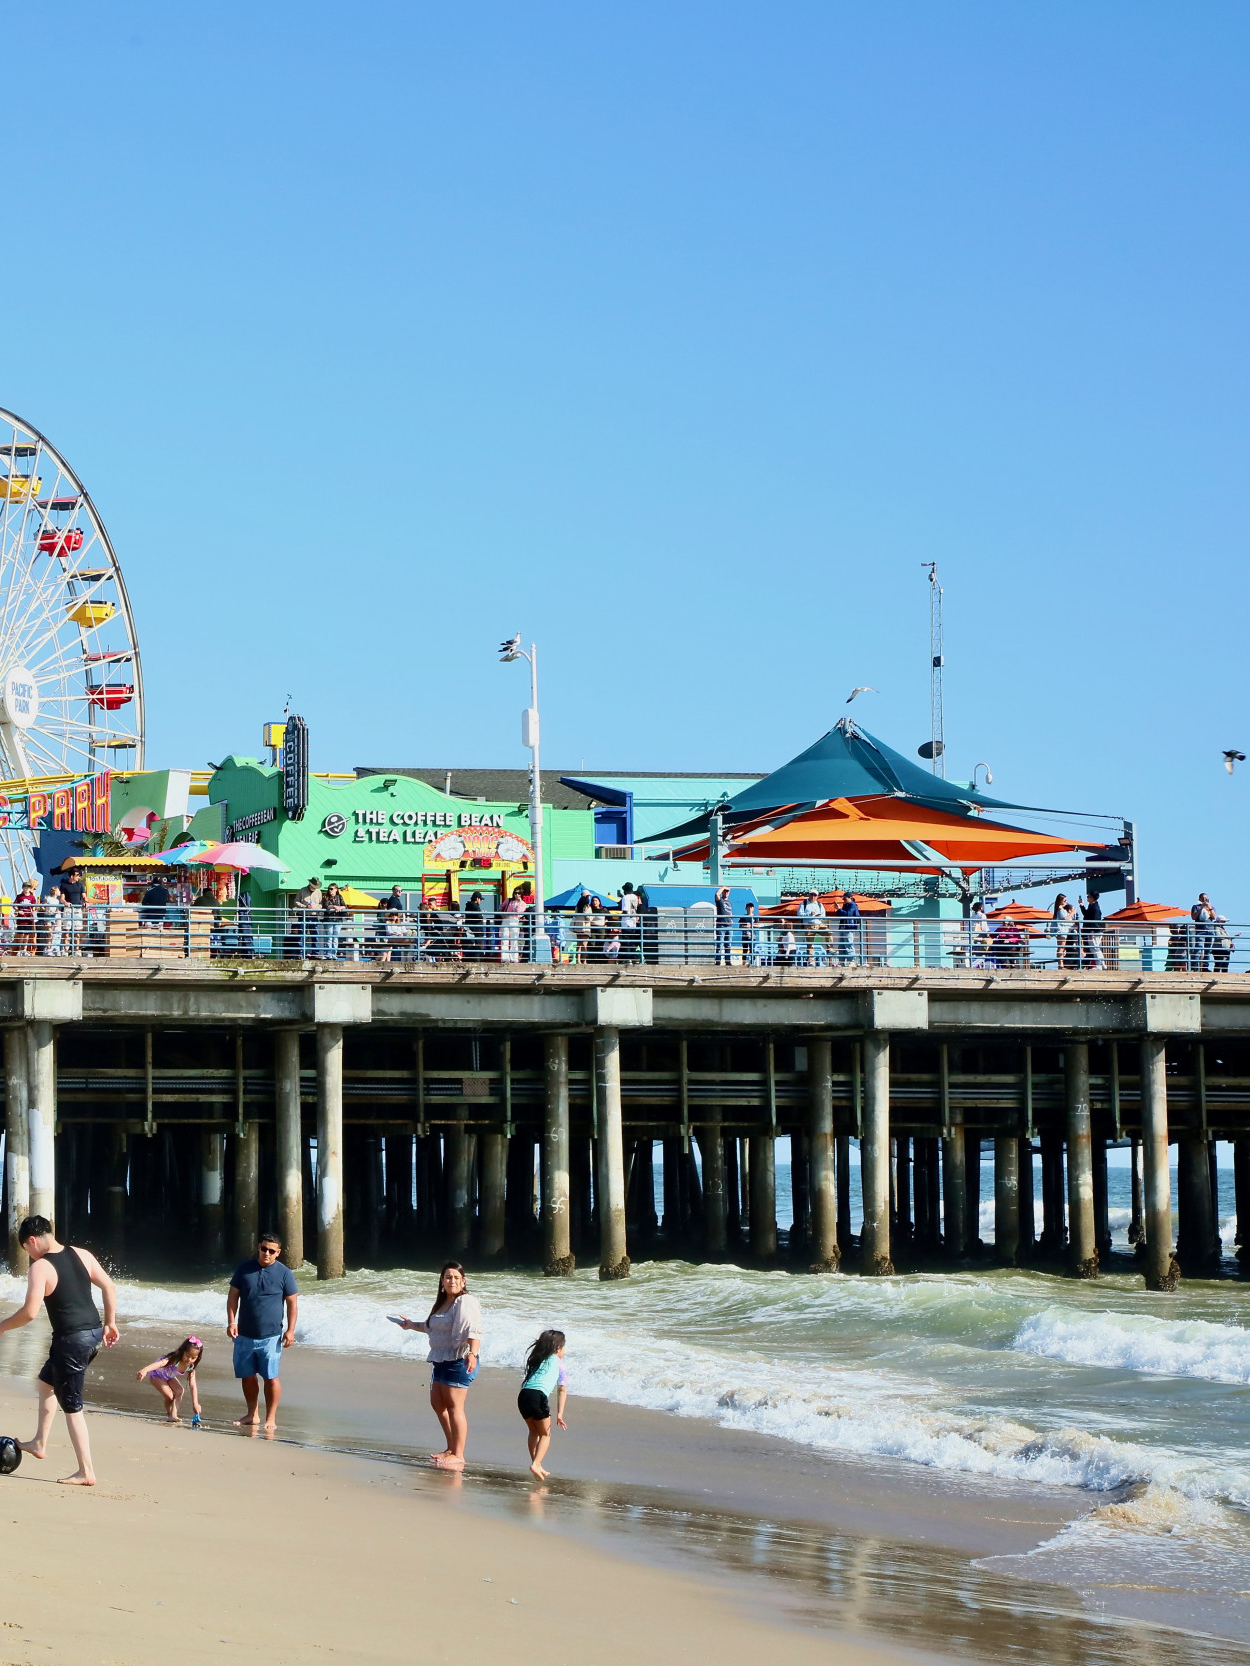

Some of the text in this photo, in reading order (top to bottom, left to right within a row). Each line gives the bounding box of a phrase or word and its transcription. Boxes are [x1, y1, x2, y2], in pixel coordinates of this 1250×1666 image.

[11, 680, 33, 700] PACIFIC
[14, 698, 30, 715] PARK
[285, 741, 295, 808] COFFEE
[28, 769, 112, 833] PARK
[355, 809, 504, 827] THE COFFEE BEAN
[369, 828, 400, 842] TEA
[405, 829, 446, 843] LEAF
